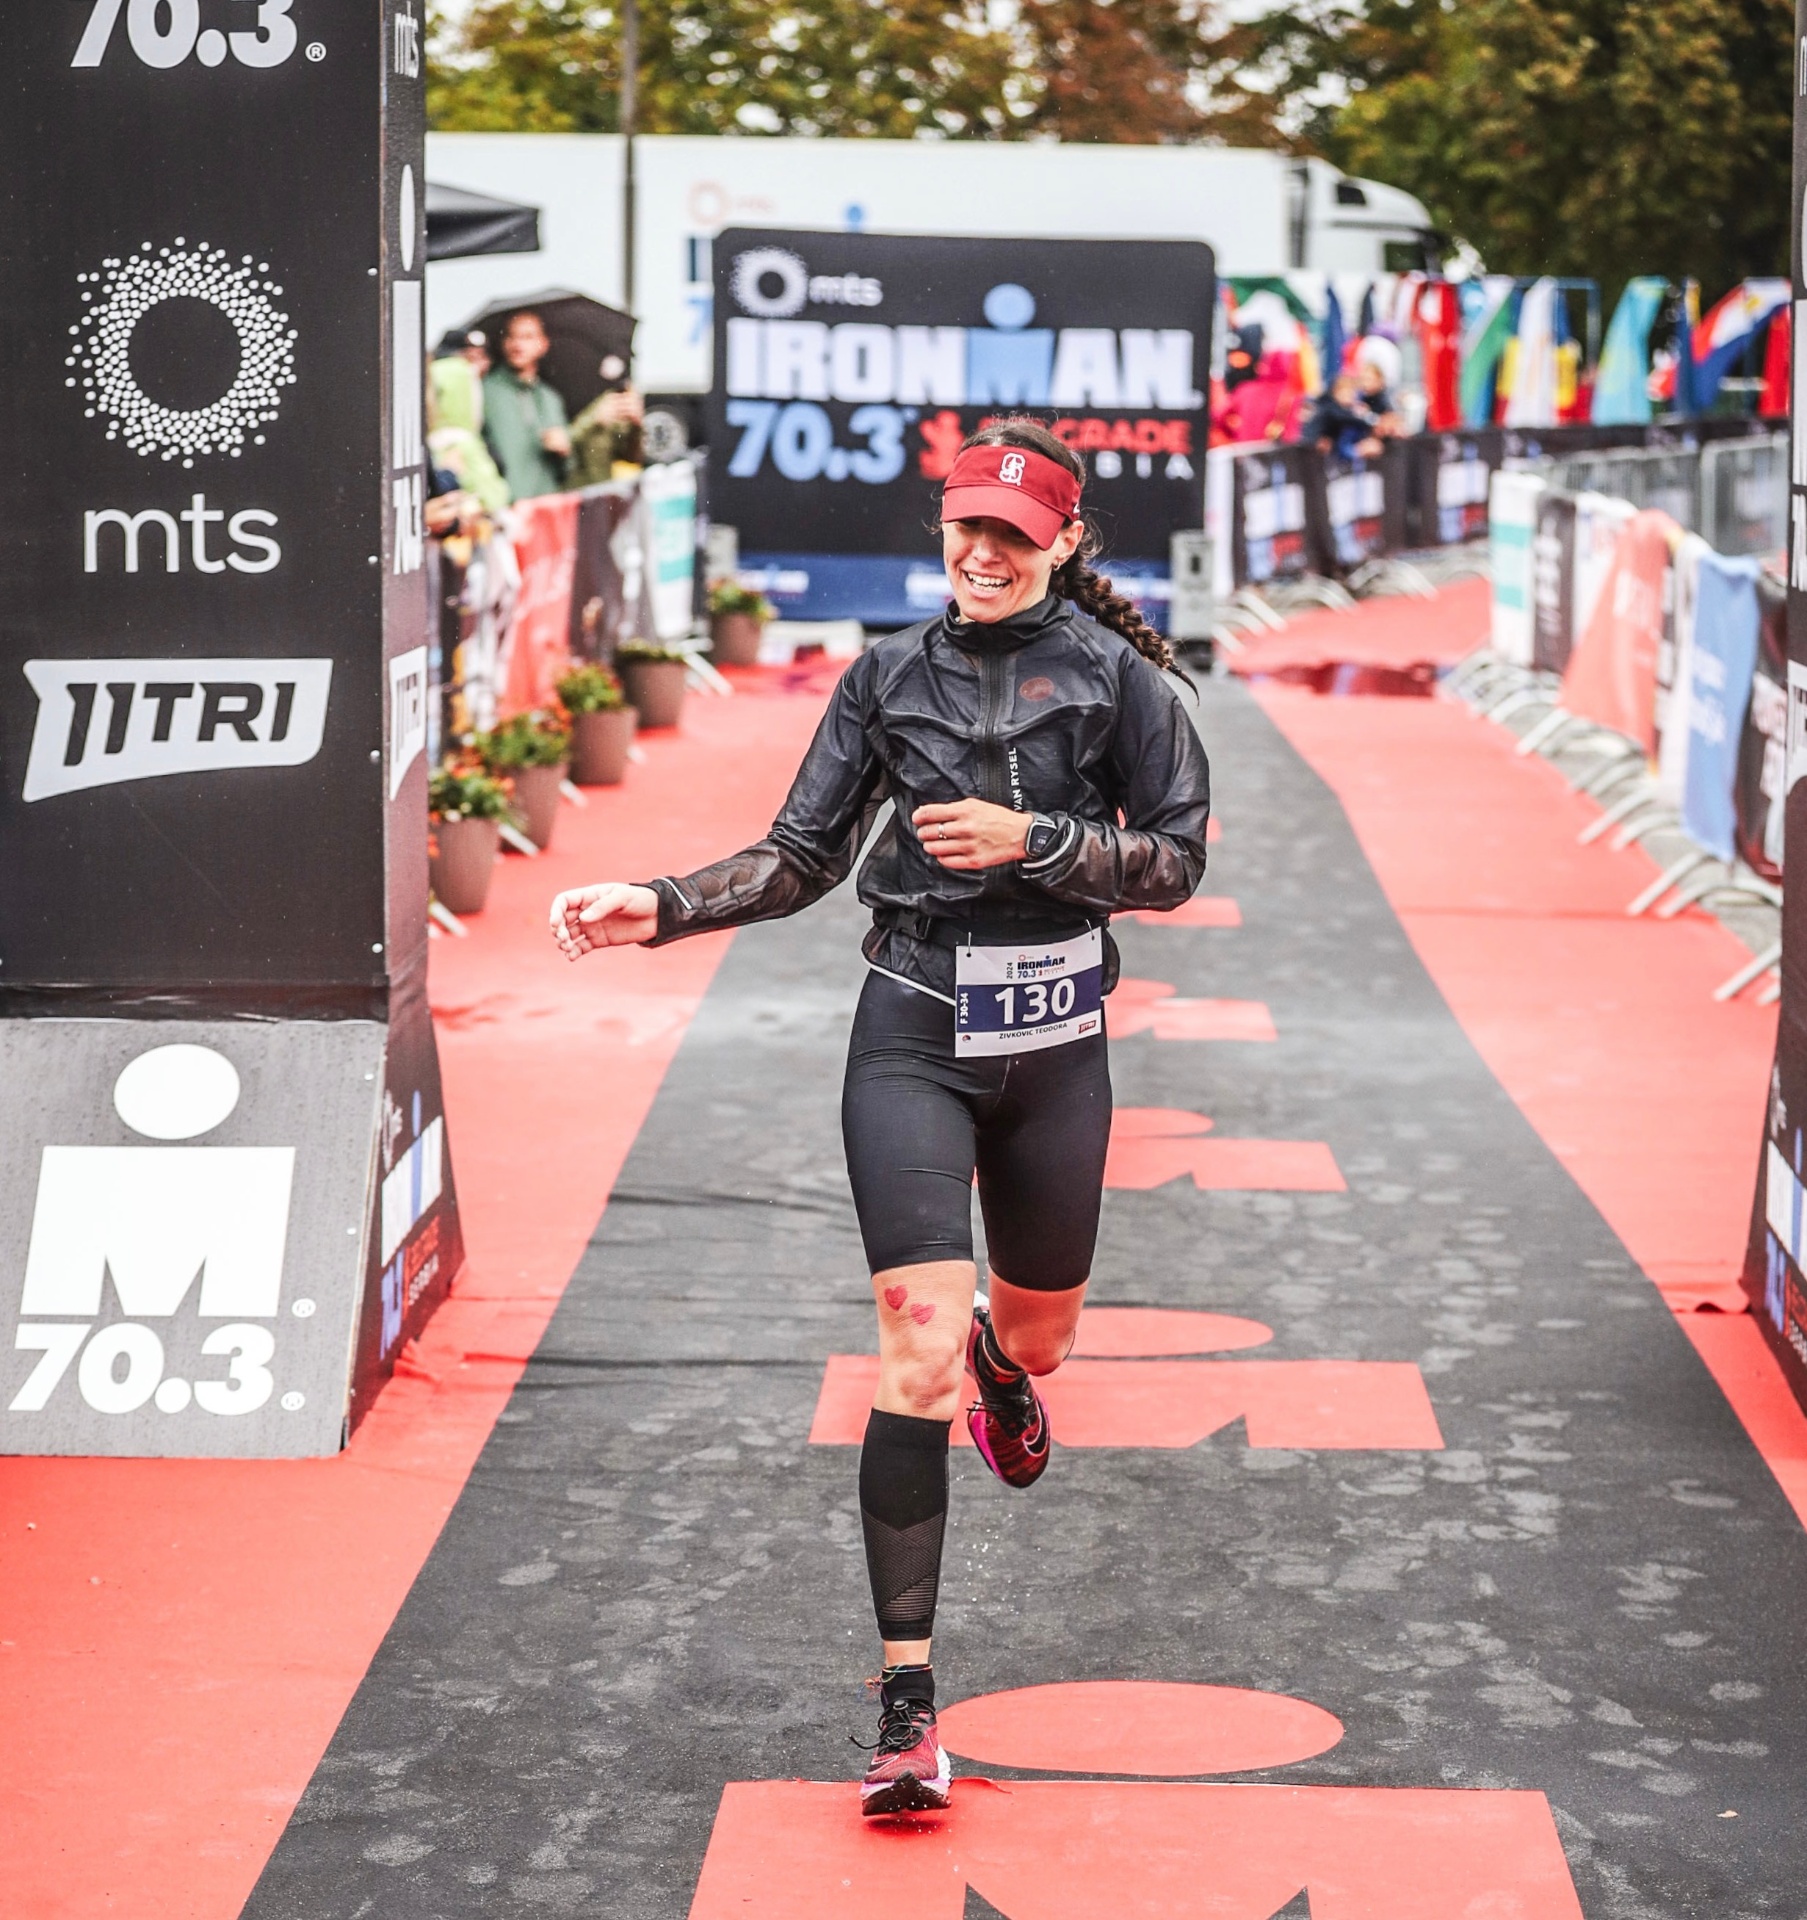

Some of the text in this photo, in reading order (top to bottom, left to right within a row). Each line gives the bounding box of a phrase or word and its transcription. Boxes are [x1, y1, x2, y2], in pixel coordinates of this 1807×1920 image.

[726, 318, 1194, 409] IRONMAN
[726, 401, 906, 484] 70.3
[83, 493, 282, 574] mts
[1008, 747, 1023, 812] VAN RYSEL
[1006, 962, 1014, 979] 2024
[1017, 956, 1066, 970] IRONMAN
[1017, 970, 1036, 979] 70.3
[960, 993, 968, 1016] 30-34
[994, 978, 1075, 1025] 130
[999, 1029, 1034, 1040] ZIVKOVIC
[1035, 1022, 1068, 1034] TEODORA
[8, 1322, 276, 1416] 70.3
